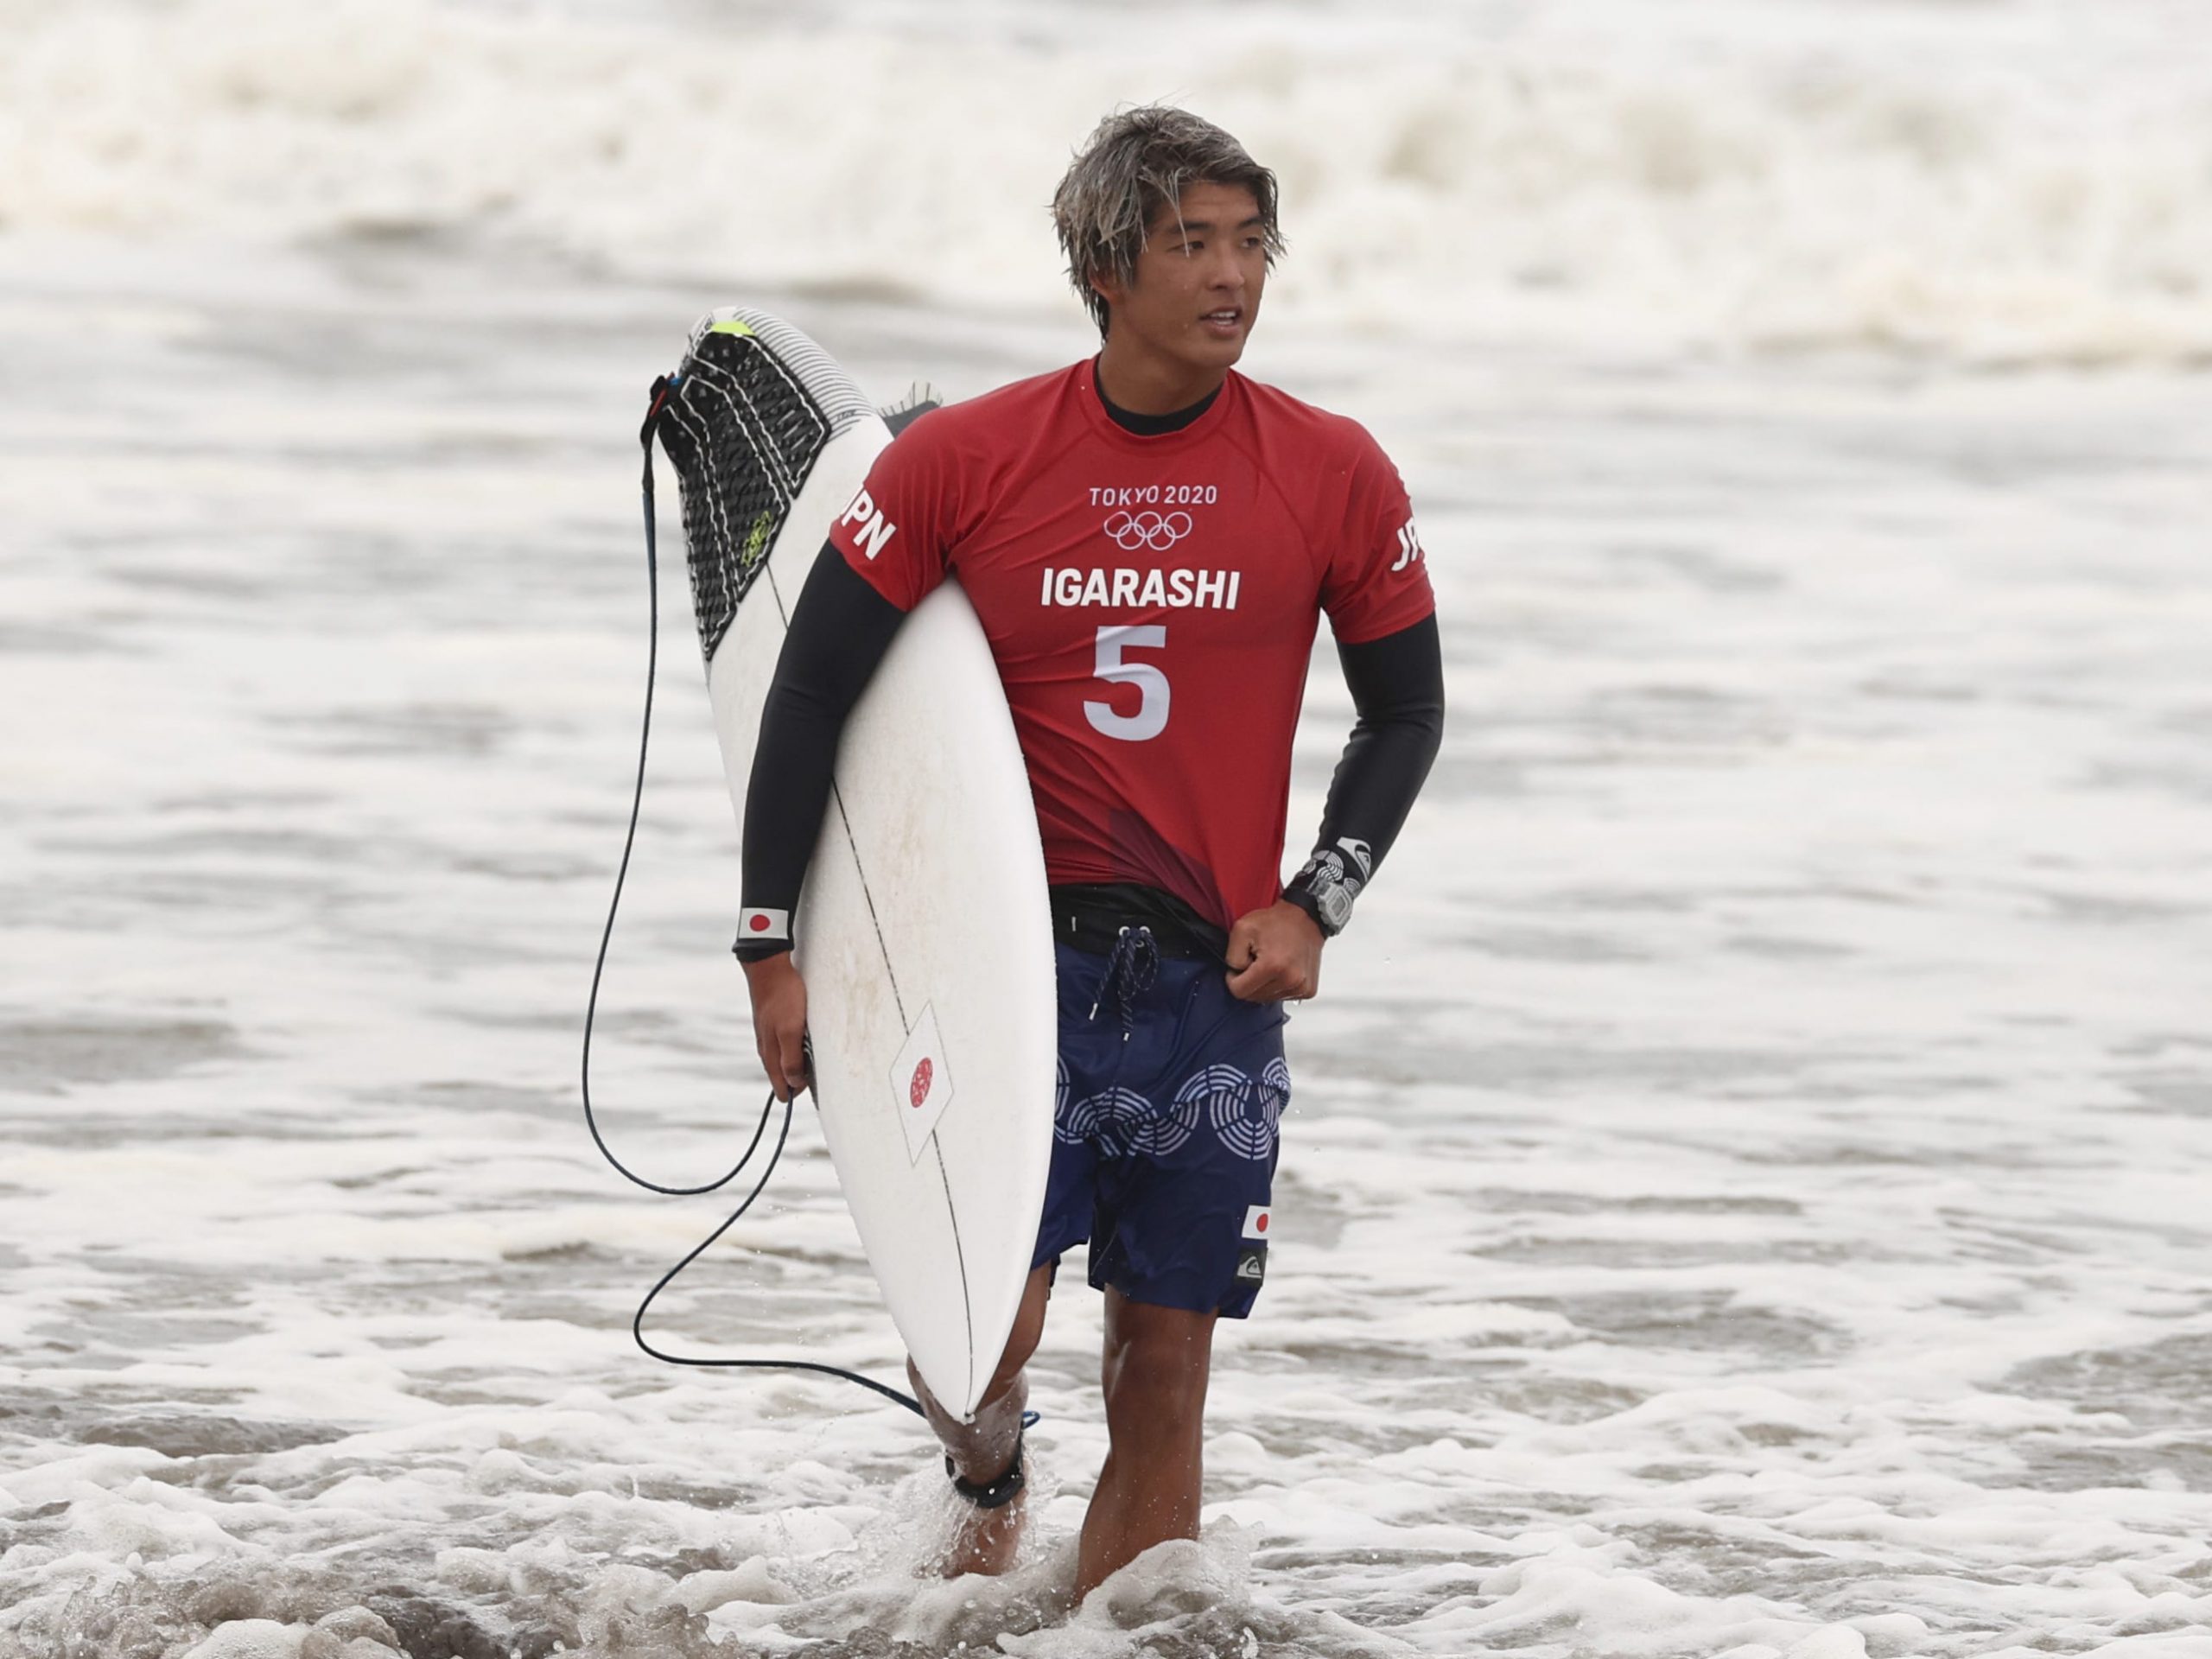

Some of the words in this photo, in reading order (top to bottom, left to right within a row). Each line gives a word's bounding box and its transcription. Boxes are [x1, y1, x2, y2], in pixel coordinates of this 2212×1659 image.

[840, 486, 897, 561] PN
[1089, 485, 1160, 506] TOKYO
[1163, 485, 1217, 505] 2020
[1041, 568, 1241, 610] IGARASHI
[1083, 625, 1171, 741] 5
